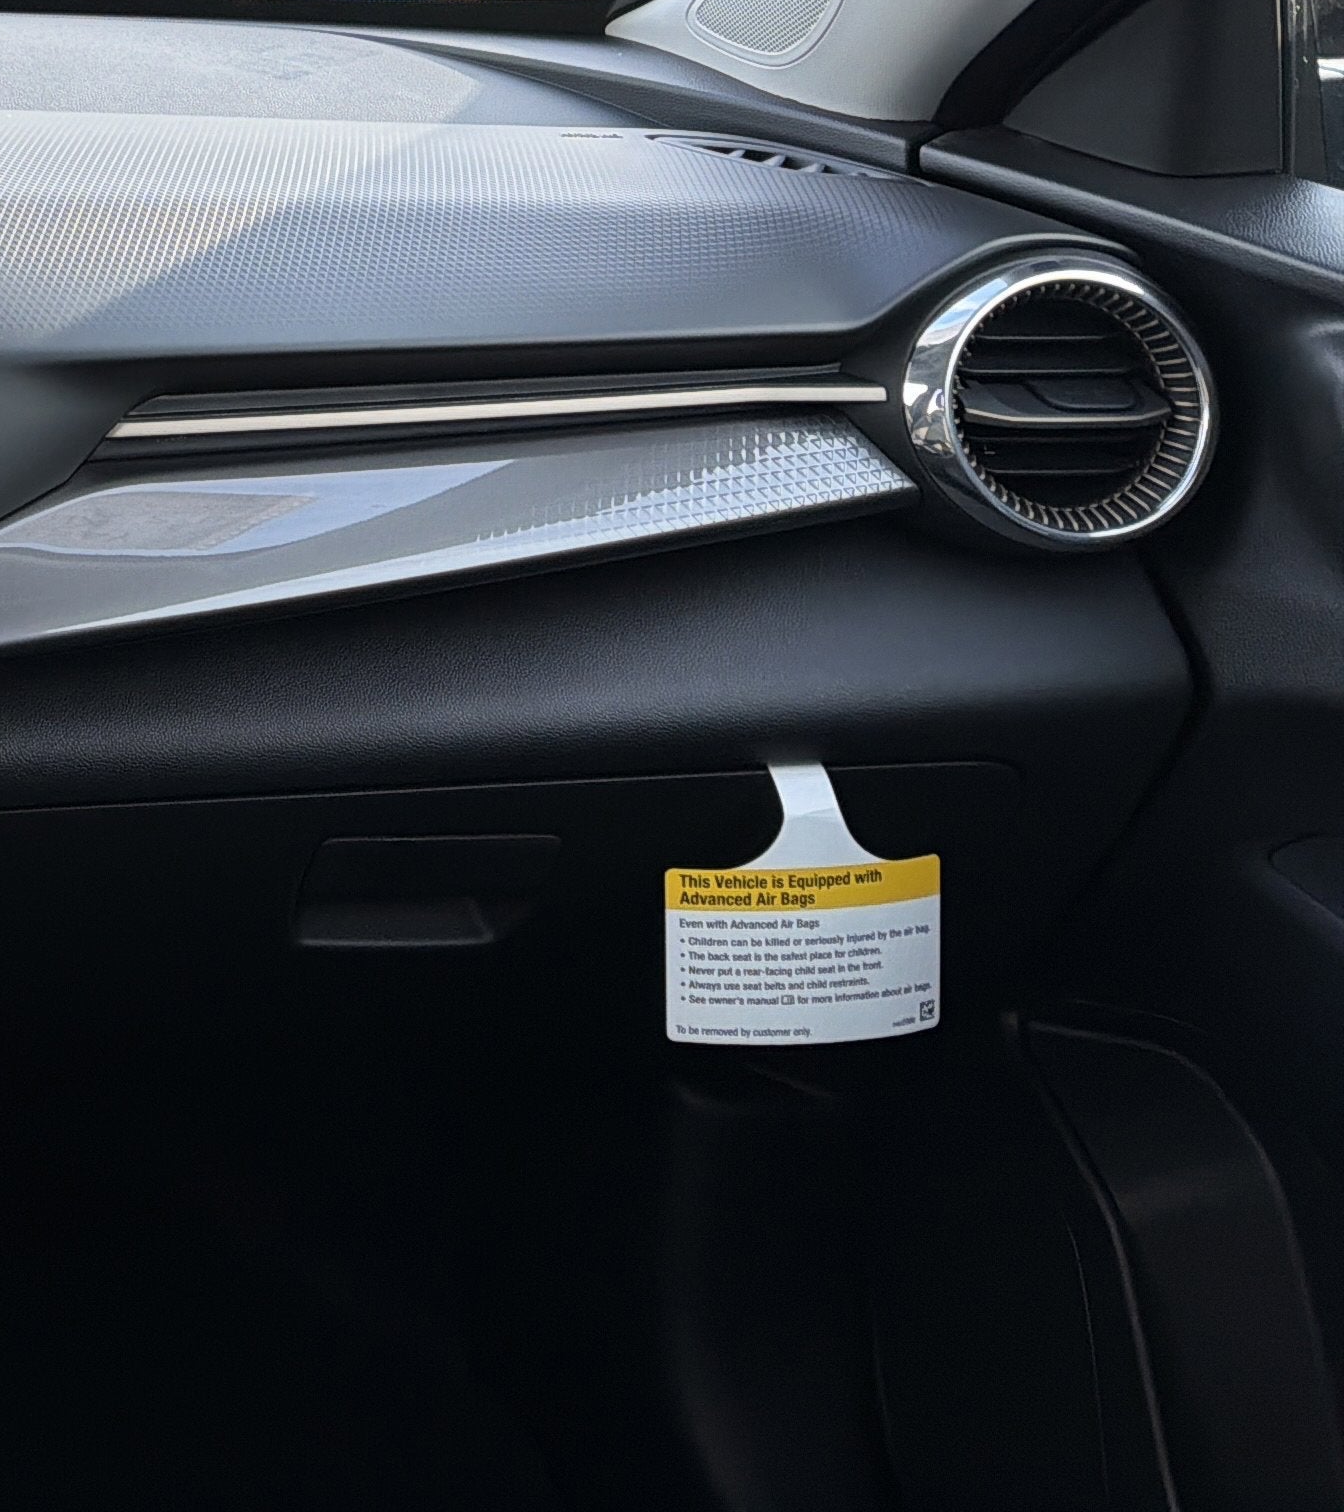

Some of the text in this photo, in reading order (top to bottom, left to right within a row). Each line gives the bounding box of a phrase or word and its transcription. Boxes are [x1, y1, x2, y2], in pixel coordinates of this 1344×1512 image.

[679, 868, 883, 892] This Vehicle is Equipped with
[679, 891, 816, 908] Advanced Air Bags
[679, 918, 820, 930] Even with Advanced Air Bags
[688, 936, 729, 947] Children
[731, 938, 749, 947] can
[751, 937, 763, 947] be
[764, 937, 791, 947] killed
[793, 938, 803, 947] or
[804, 935, 845, 946] seriously
[846, 931, 876, 945] injured
[877, 930, 887, 942] by
[889, 928, 903, 939] the
[688, 951, 706, 962] The
[707, 952, 730, 962] back
[732, 952, 753, 962] seat
[764, 952, 779, 962] the
[780, 951, 808, 962] safest
[809, 950, 833, 962] place
[834, 949, 847, 959] for
[847, 947, 883, 958] children.
[688, 965, 716, 976] Never
[717, 967, 733, 977] put
[743, 966, 793, 978] rear-facing
[794, 965, 816, 976] child
[817, 964, 836, 975] seat
[847, 963, 861, 973] the
[688, 977, 870, 992] Always use seat belts and child restraints.
[688, 994, 707, 1005] See
[708, 995, 745, 1005] owner's
[746, 995, 780, 1006] manual
[797, 995, 809, 1005] for
[811, 994, 833, 1004] more
[834, 990, 880, 1003] information
[881, 987, 903, 998] about
[675, 1025, 813, 1039] To be removed by customer only.
